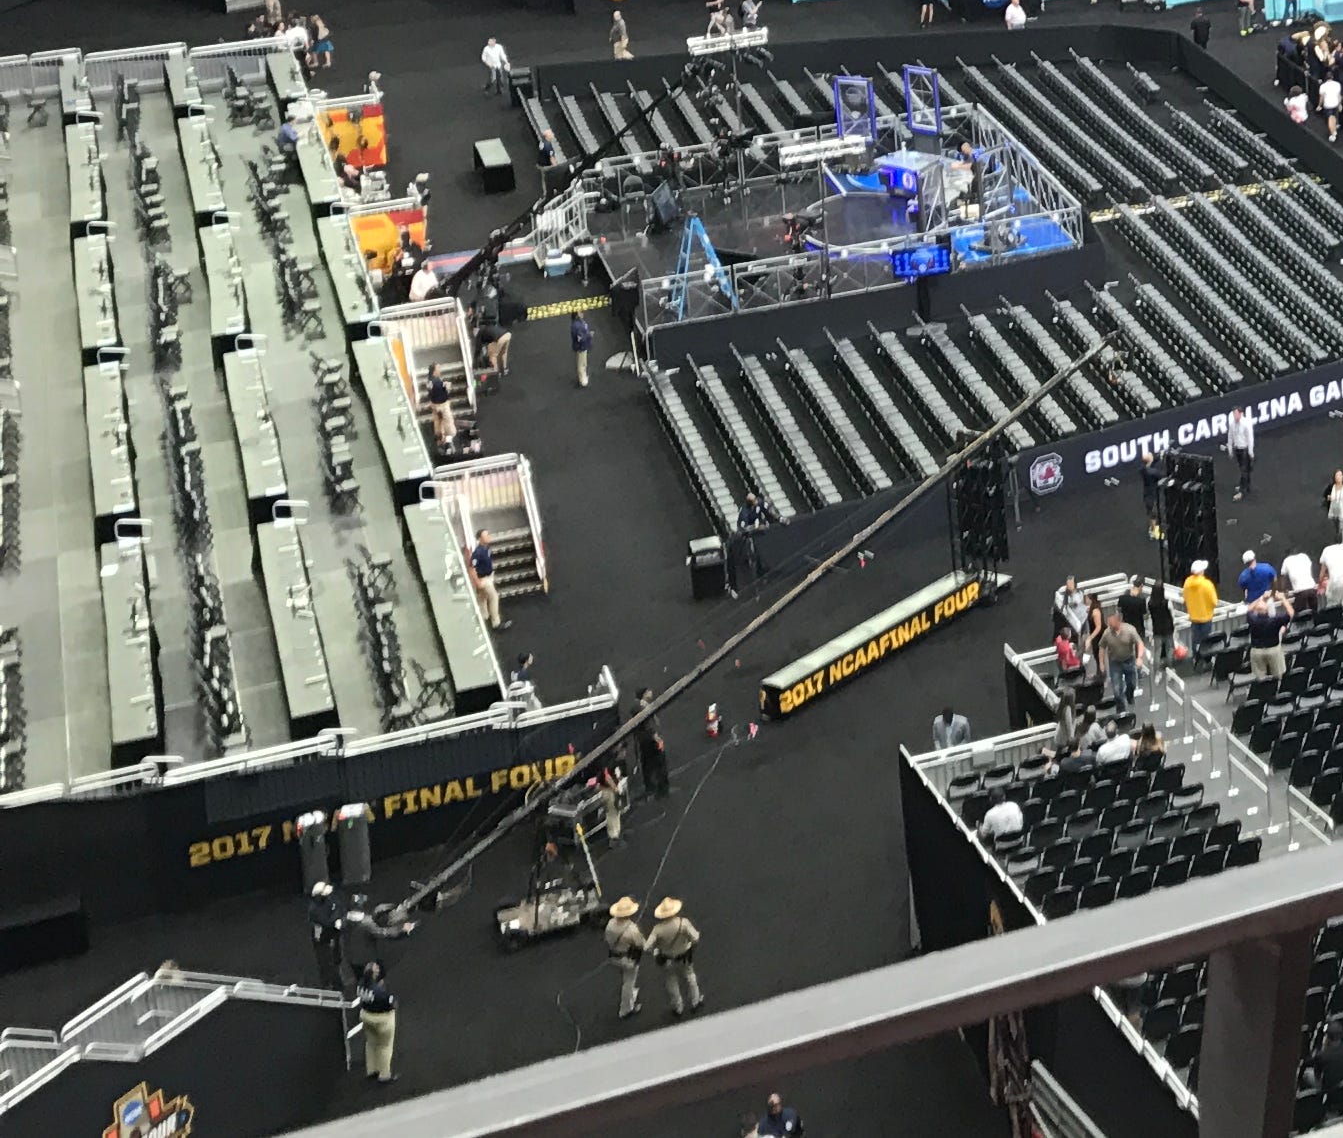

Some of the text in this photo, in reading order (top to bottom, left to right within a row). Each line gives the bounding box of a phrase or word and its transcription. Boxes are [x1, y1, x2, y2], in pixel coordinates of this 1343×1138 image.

[1084, 428, 1170, 474] SOUTH
[778, 670, 825, 714] 2017
[934, 581, 980, 624] FOUR
[189, 755, 577, 867] 2017 FINAL FOUR
